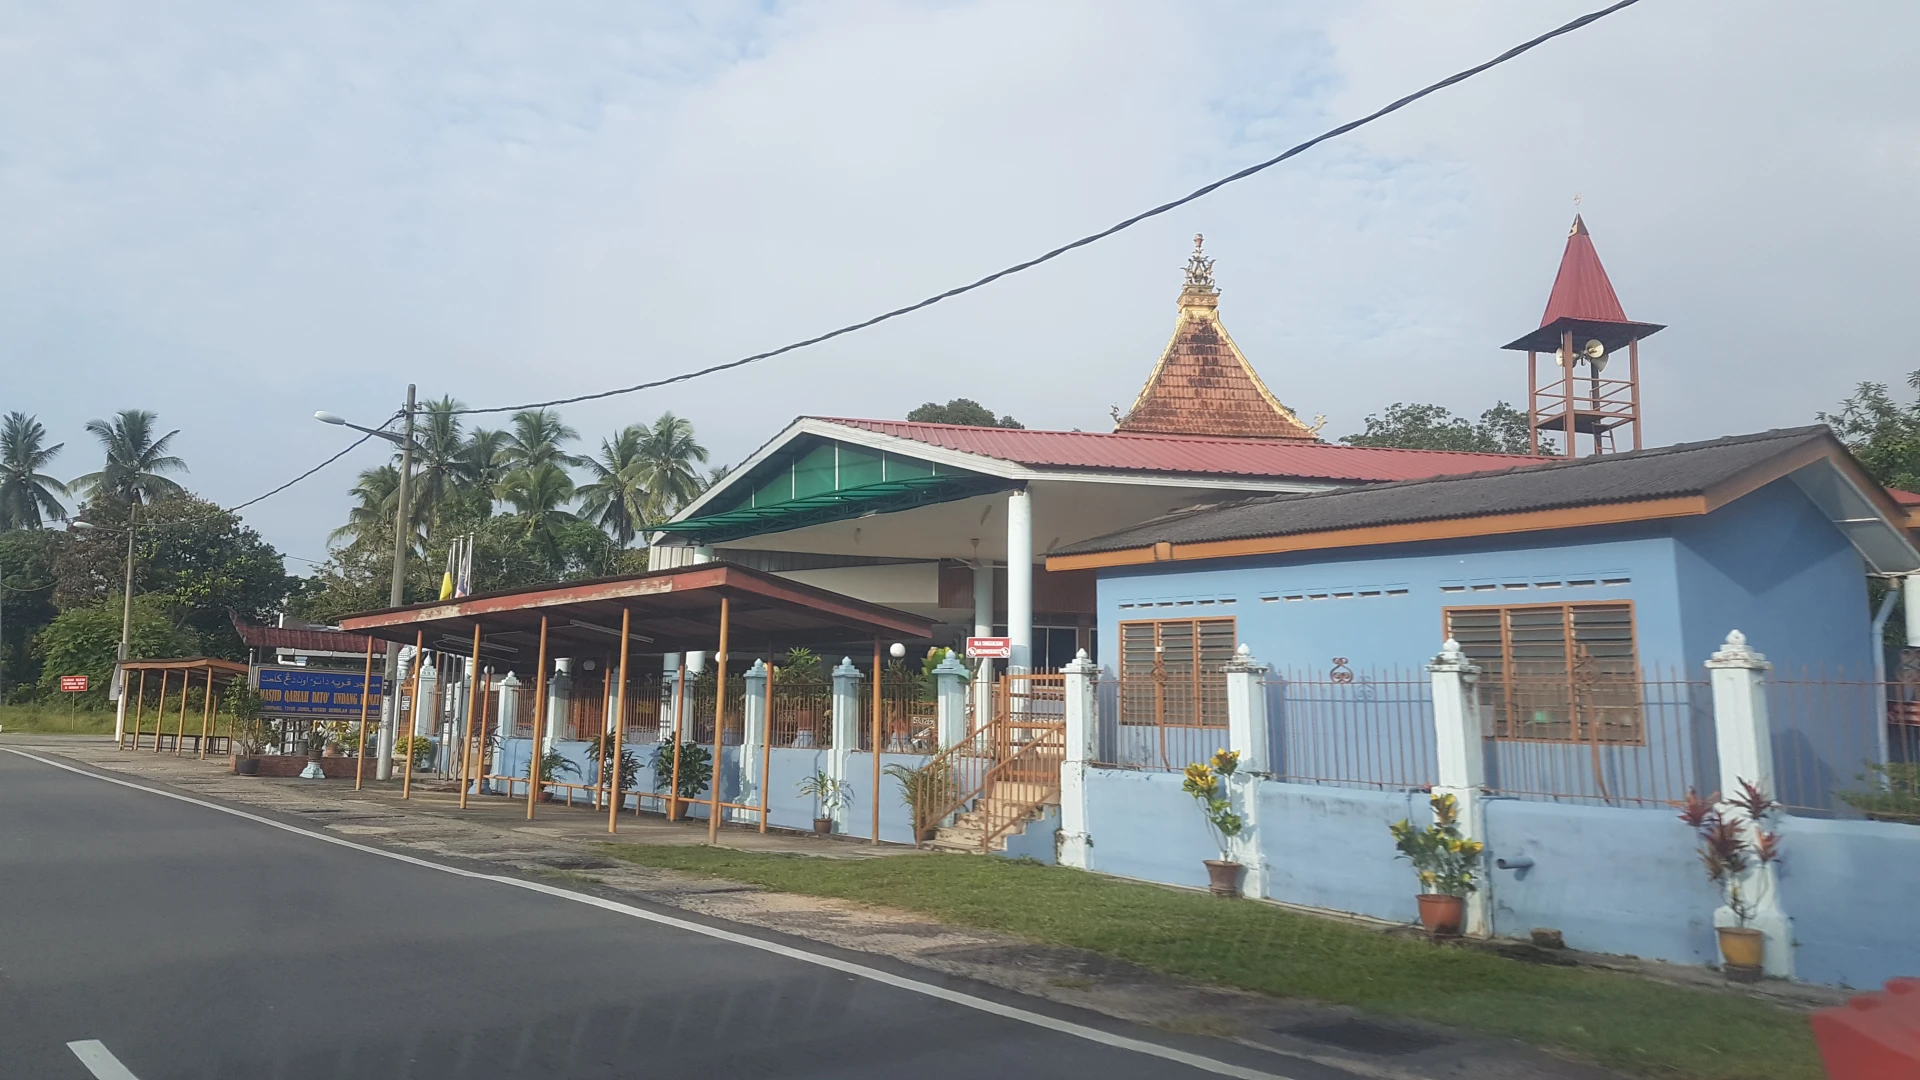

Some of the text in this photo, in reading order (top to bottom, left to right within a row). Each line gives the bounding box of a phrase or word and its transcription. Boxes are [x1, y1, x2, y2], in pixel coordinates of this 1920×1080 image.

[260, 688, 282, 703] MASJID
[284, 690, 309, 703] QARIAH
[333, 693, 358, 705] UNDANG
